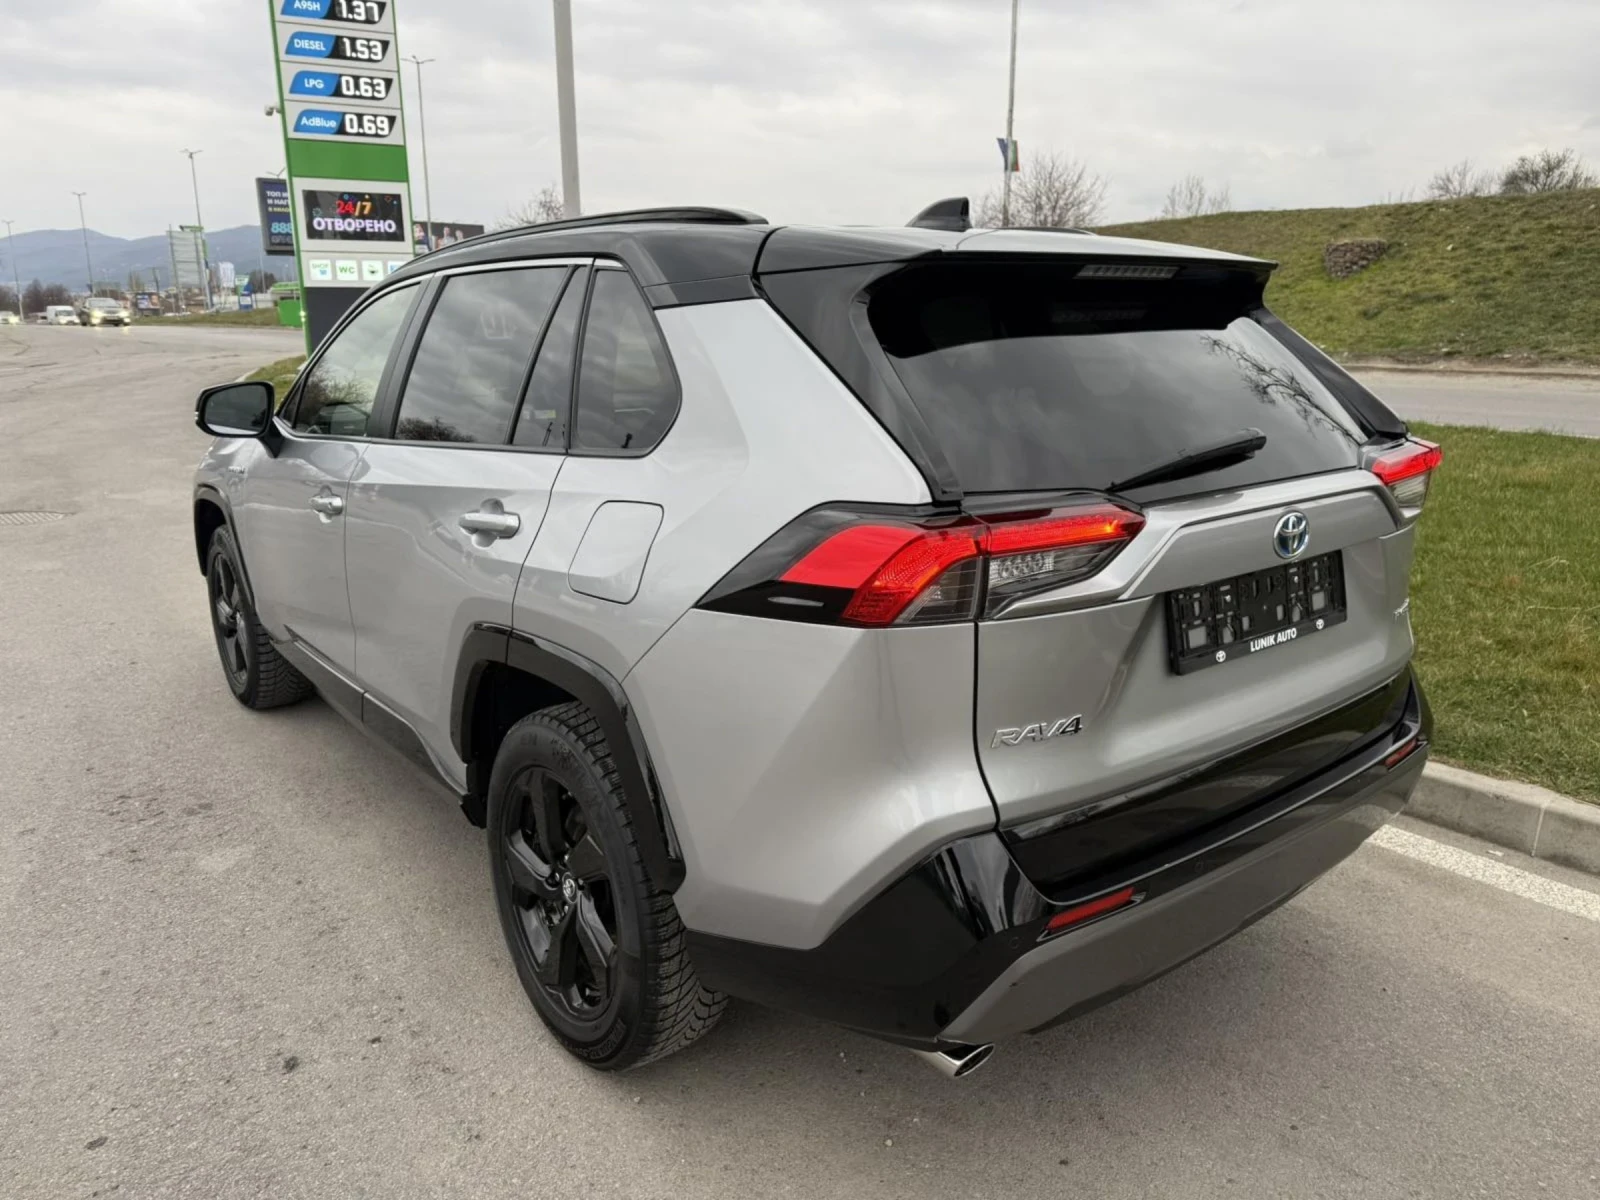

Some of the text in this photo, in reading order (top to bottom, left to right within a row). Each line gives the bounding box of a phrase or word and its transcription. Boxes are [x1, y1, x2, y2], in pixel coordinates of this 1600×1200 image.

[293, 0, 380, 22] A95H 1.37
[293, 37, 383, 60] DIESEL 1.53
[304, 76, 386, 99] LPG 0.63
[301, 114, 390, 136] AdBlue 0.69
[336, 200, 372, 216] 24/7
[312, 217, 396, 232] ОТВОРЕНО
[340, 266, 355, 274] WC
[1250, 627, 1297, 652] LUNIK AUTO
[990, 714, 1083, 748] RAV4
